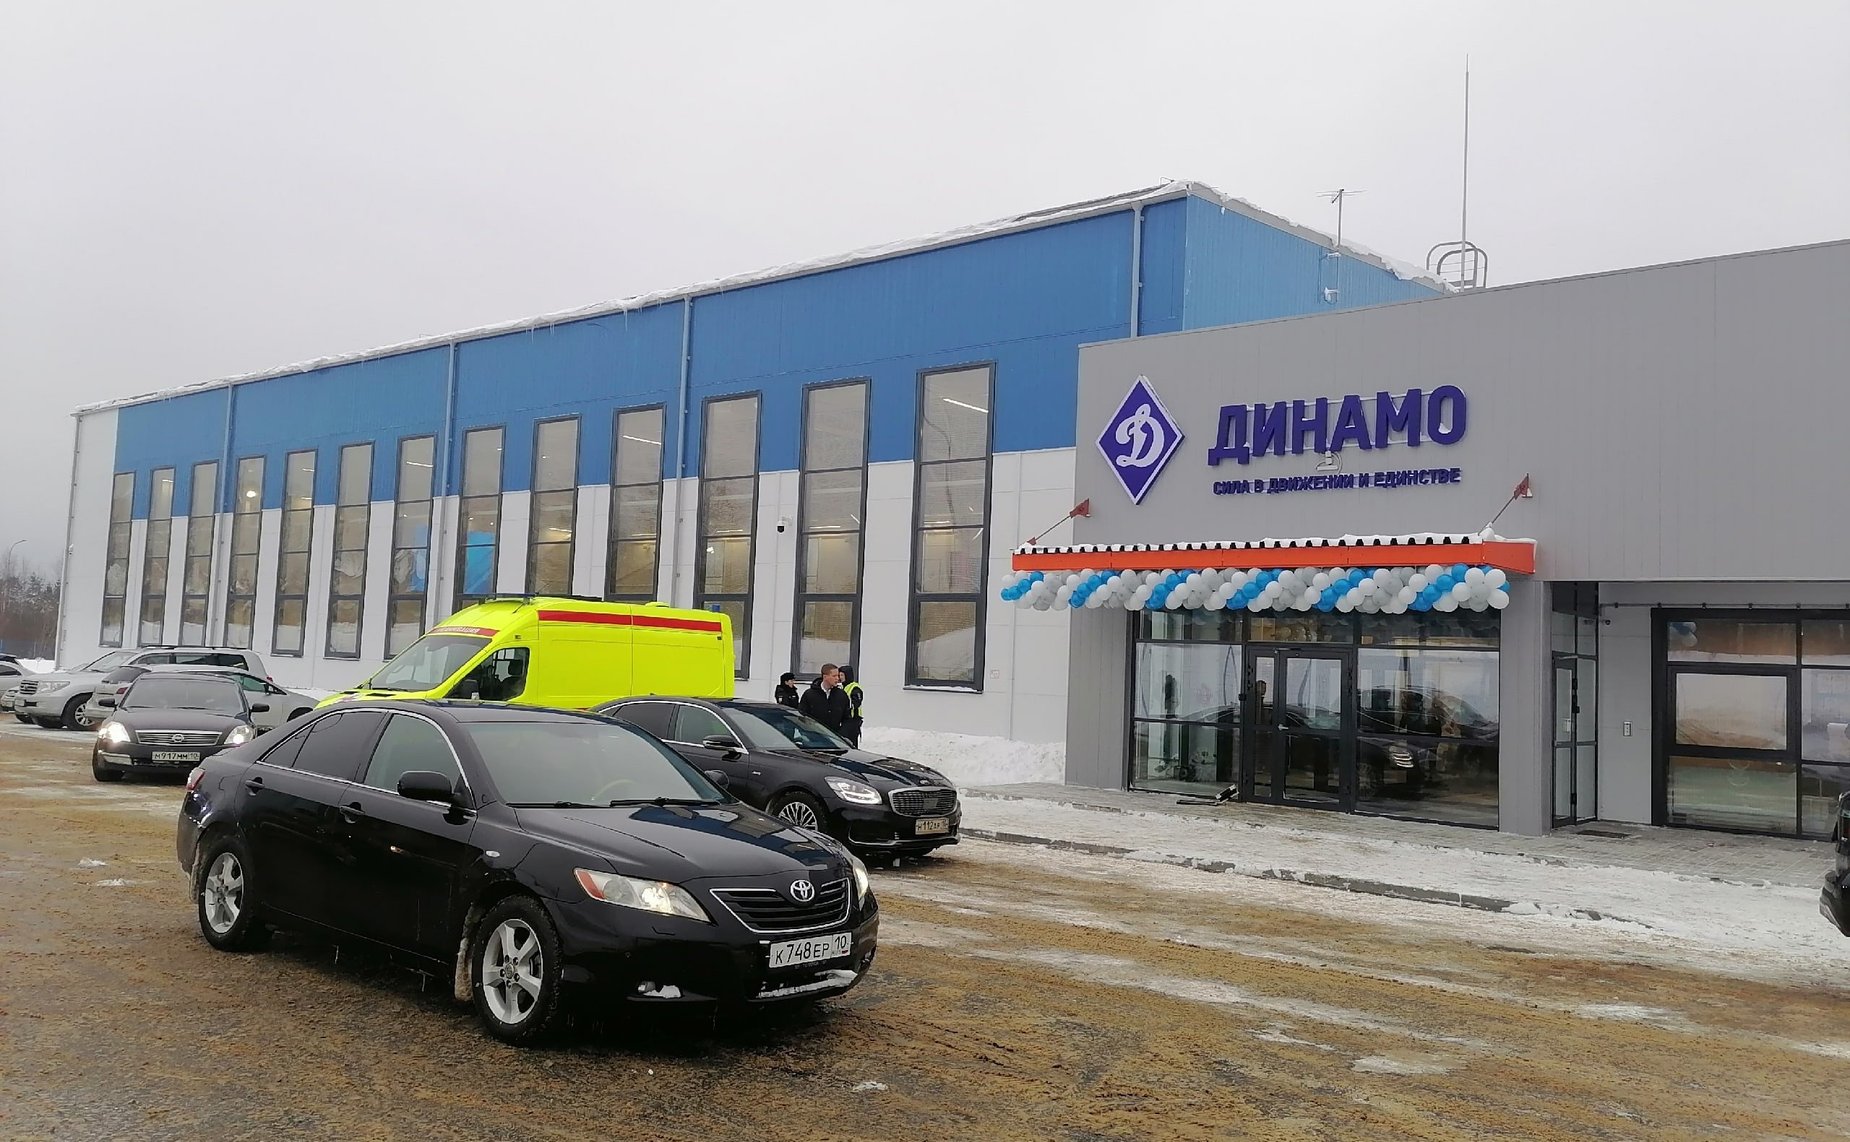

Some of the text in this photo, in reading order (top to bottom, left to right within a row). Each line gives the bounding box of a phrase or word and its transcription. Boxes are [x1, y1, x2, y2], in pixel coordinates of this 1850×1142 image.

[1208, 385, 1467, 466] ДИНАМО
[1213, 468, 1461, 495] СИЛА В ДВИЖЕНИИ И ЕДИНСТВЕ
[775, 935, 847, 964] К748ЕР 10
